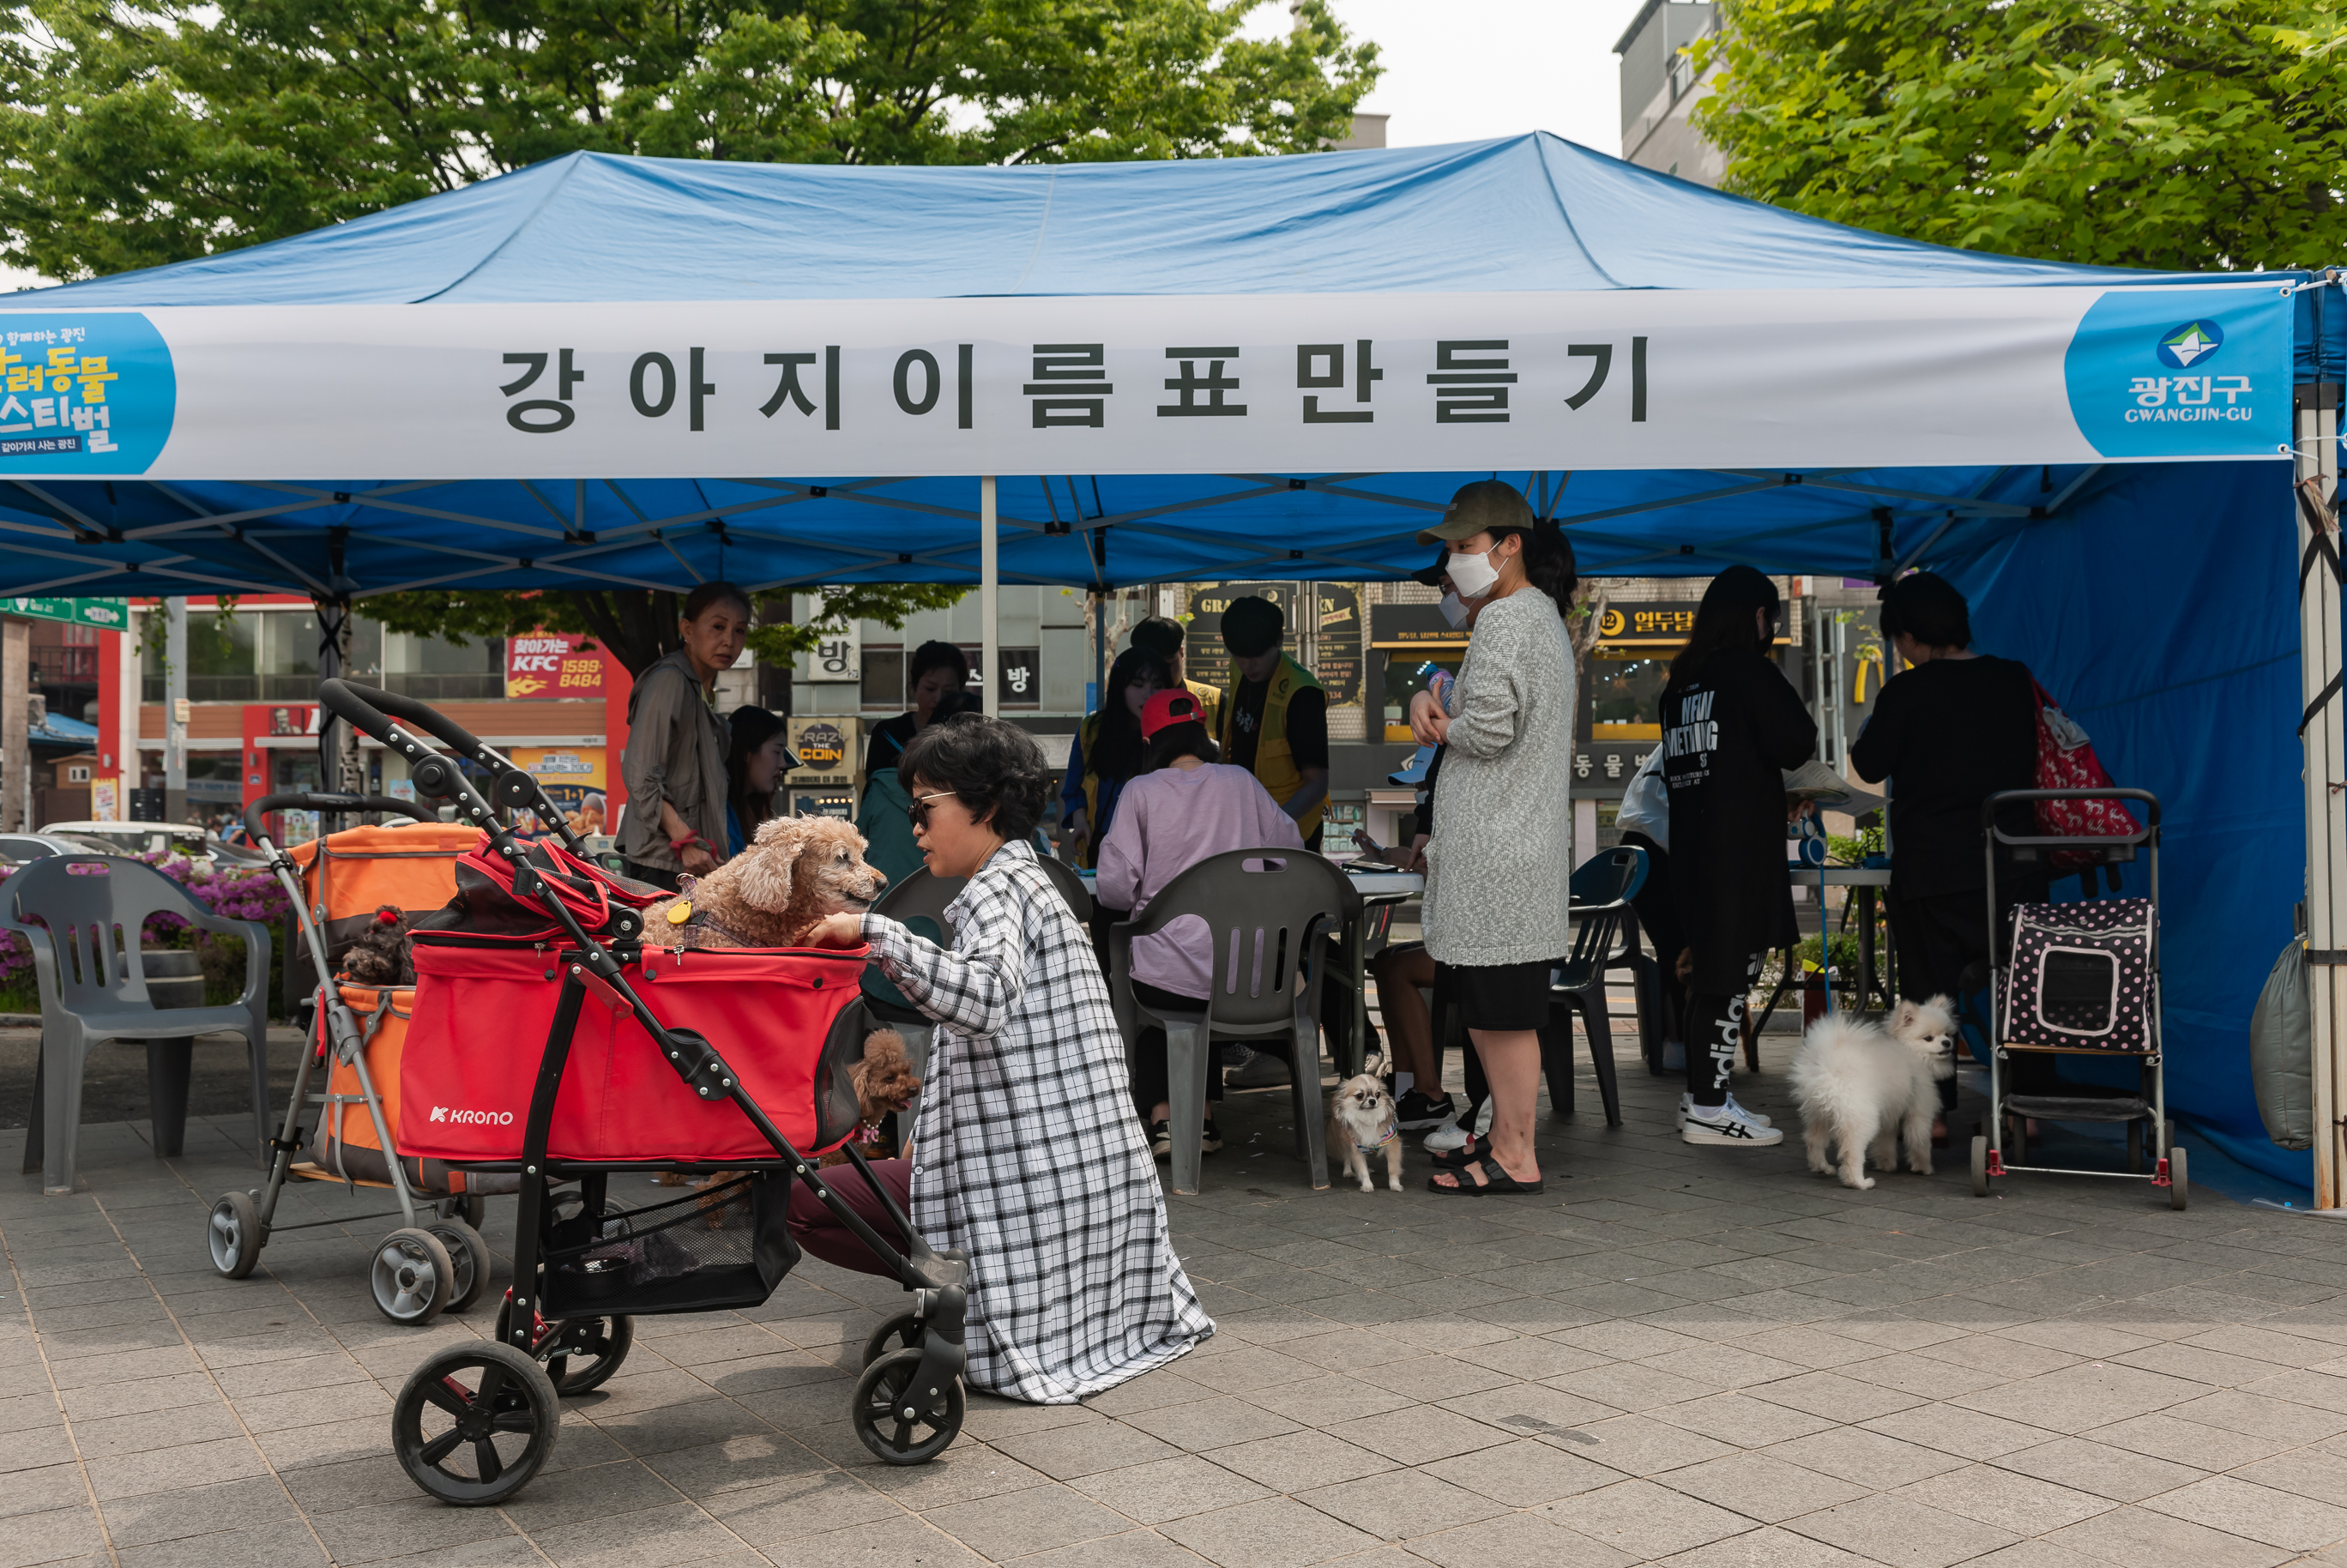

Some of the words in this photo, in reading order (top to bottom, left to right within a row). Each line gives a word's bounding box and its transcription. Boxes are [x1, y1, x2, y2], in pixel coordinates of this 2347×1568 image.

[7, 329, 57, 346] 함께하는
[60, 327, 85, 343] 광진
[2128, 375, 2253, 407] 광진구
[2124, 407, 2253, 423] GWANGJIN-GU
[38, 440, 57, 451] 사는
[57, 438, 76, 450] 광진
[1201, 599, 1235, 613] GRA
[1634, 611, 1695, 633] 열두달
[511, 655, 559, 672] KFC
[559, 673, 602, 688] 8484
[1006, 666, 1031, 693] 방
[1681, 690, 1716, 726] NEW
[793, 732, 851, 744] CRAZY
[799, 747, 843, 761] COIN
[564, 788, 584, 801] 1+1
[1710, 992, 1747, 1089] adida
[449, 1109, 514, 1125] KRONO
